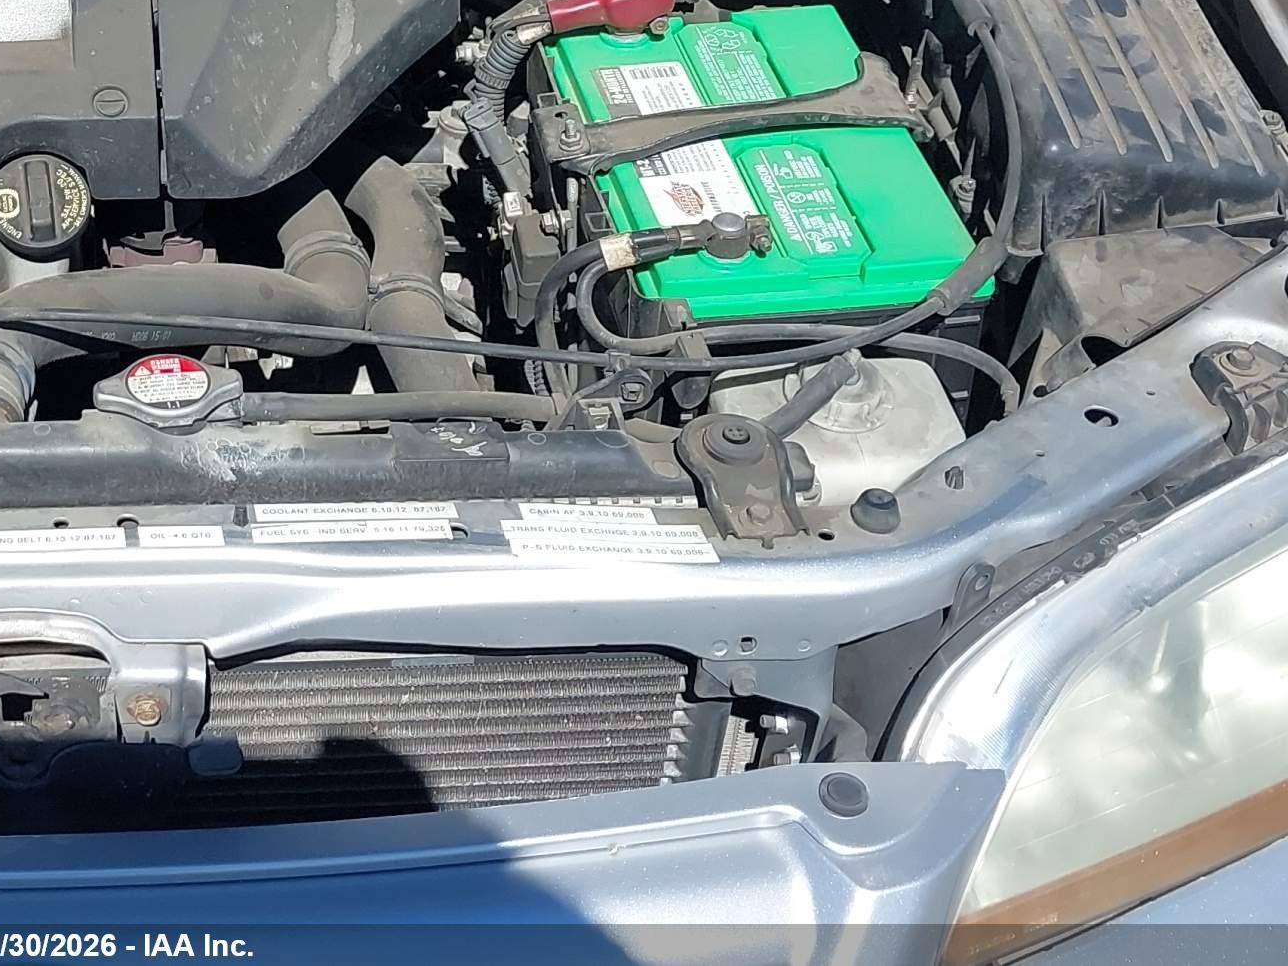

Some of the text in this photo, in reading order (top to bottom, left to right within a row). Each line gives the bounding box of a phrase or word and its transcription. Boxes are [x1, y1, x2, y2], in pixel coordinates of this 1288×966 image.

[166, 401, 181, 409] 1.1
[313, 506, 368, 514] EXCHANGE
[17, 536, 42, 544] BELT
[578, 545, 633, 553] EXCHANGE
